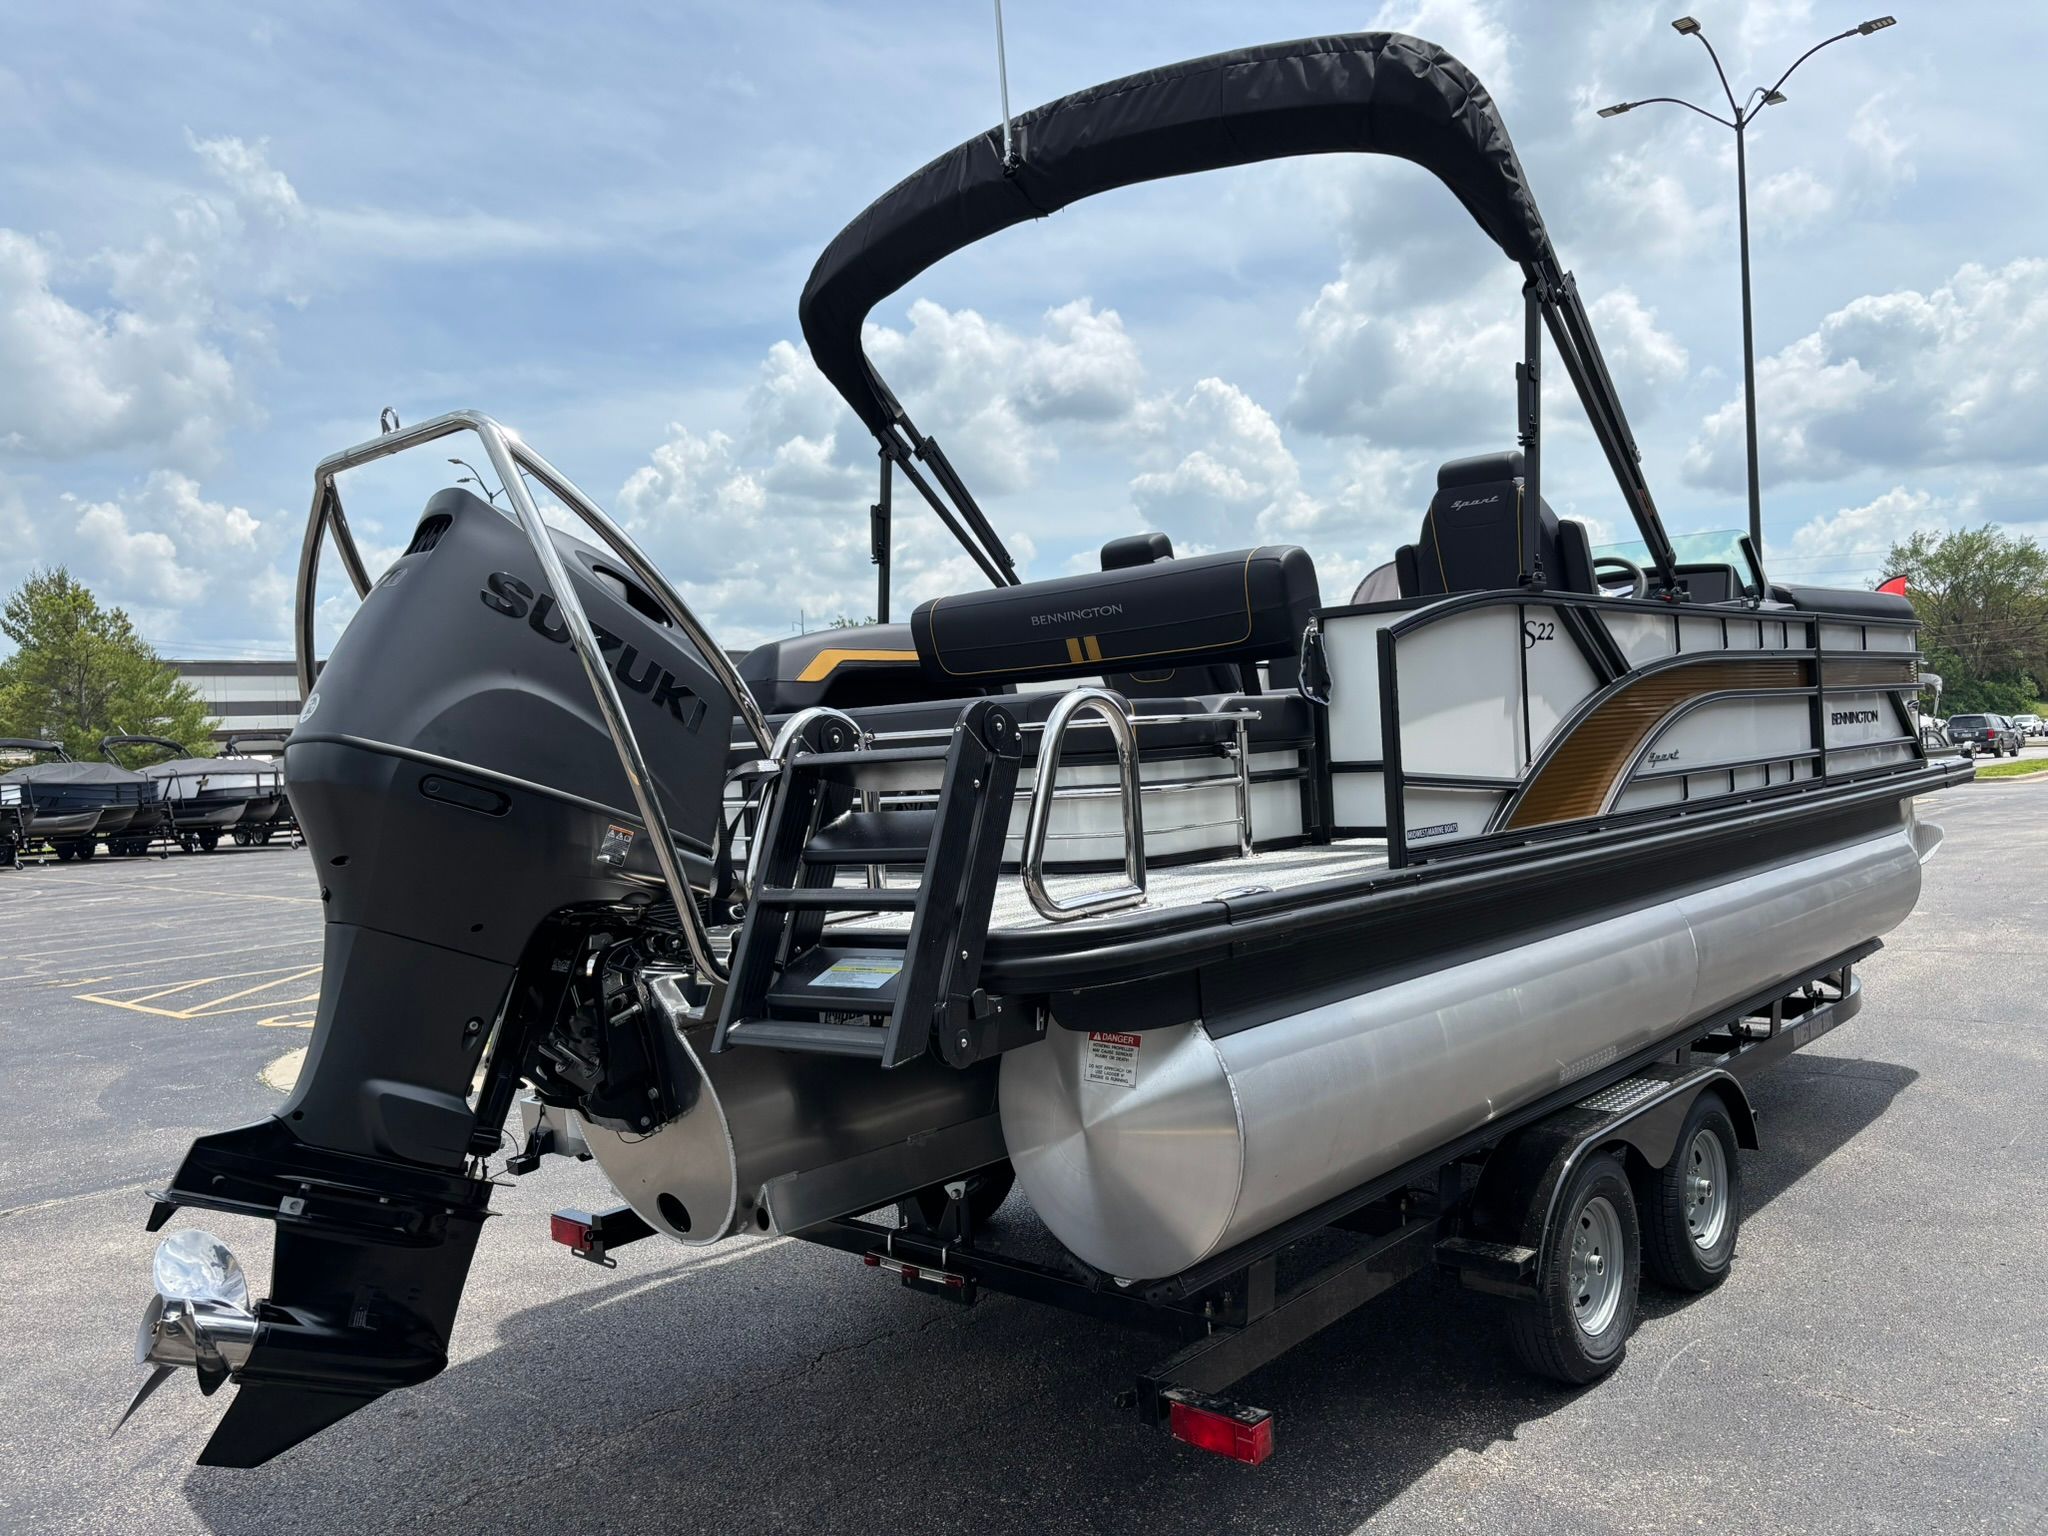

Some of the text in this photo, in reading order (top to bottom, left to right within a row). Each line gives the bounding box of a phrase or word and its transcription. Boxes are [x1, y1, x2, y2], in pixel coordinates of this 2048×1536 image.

[1450, 495, 1499, 511] Sport
[1031, 604, 1123, 626] BENNINGTON
[1524, 620, 1555, 649] S22
[1831, 710, 1878, 725] BENNINGTON
[1648, 749, 1679, 768] Sport
[1407, 824, 1457, 839] MIDWEST MARINE BOATS
[1102, 1032, 1134, 1044] DANGER
